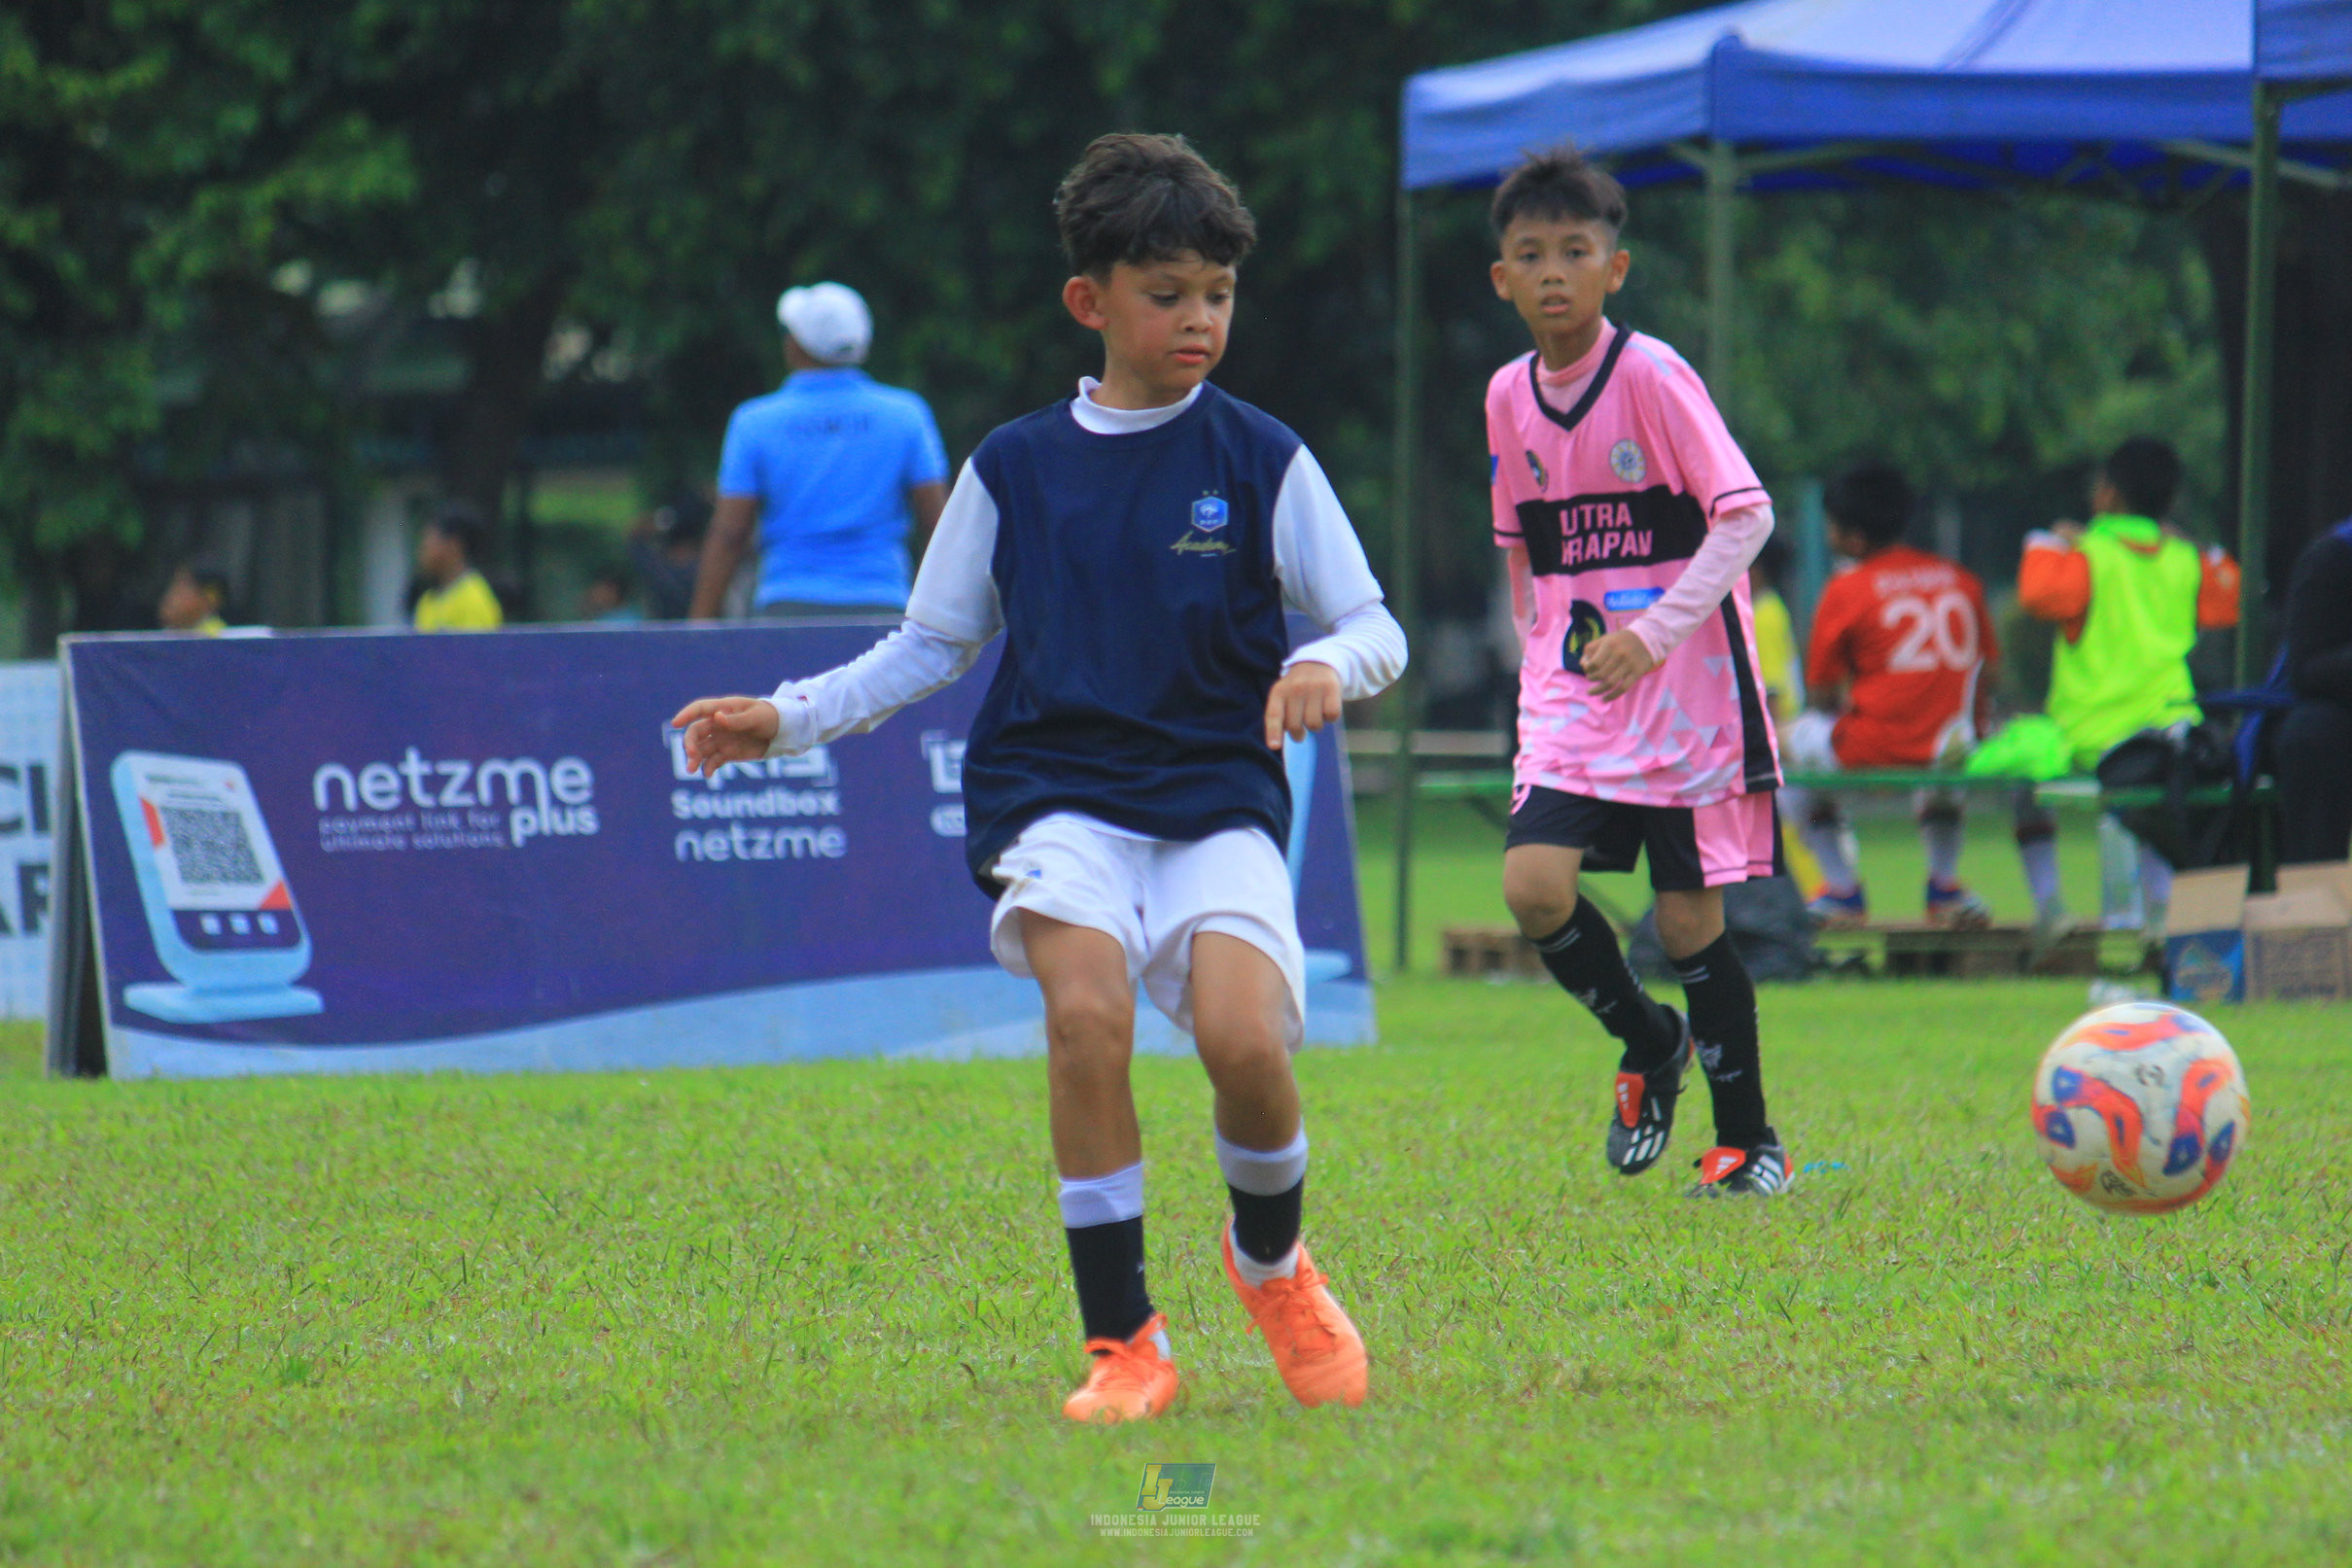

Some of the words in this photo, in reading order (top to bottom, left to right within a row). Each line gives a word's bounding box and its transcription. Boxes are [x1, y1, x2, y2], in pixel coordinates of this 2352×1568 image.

[1882, 593, 1979, 673] 20
[312, 745, 594, 813] netzme
[671, 786, 841, 819] Soundbox
[509, 804, 600, 848] plus
[674, 819, 848, 861] netzme
